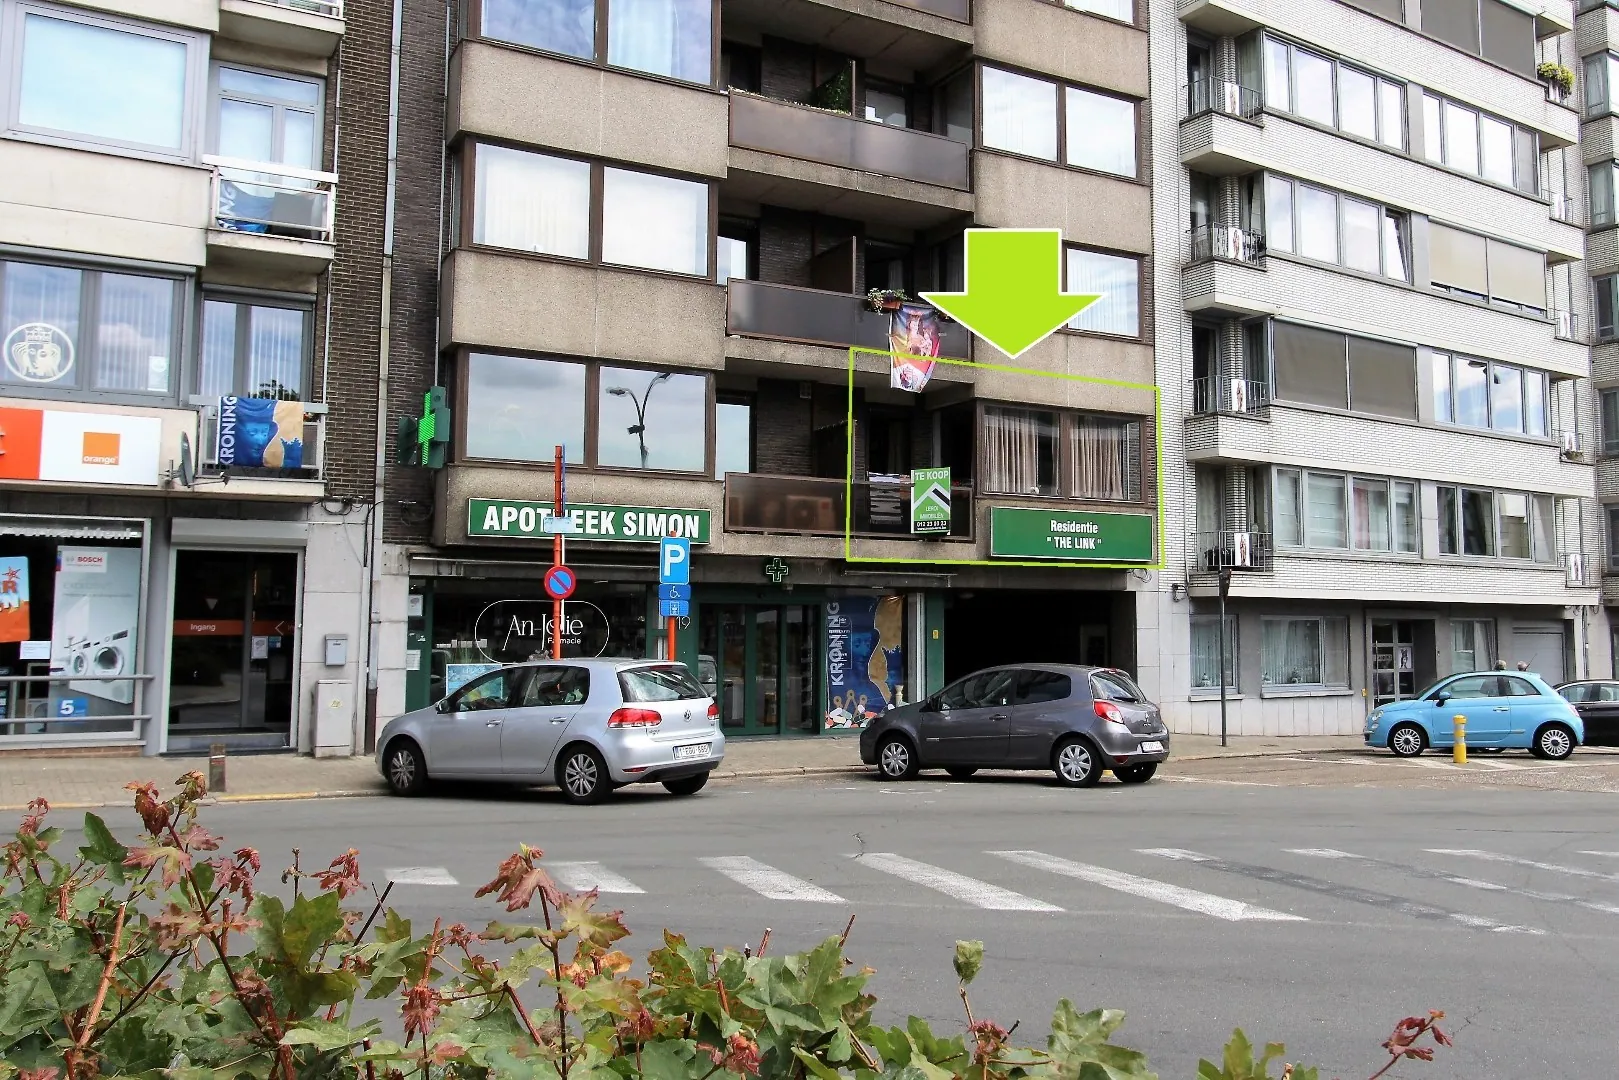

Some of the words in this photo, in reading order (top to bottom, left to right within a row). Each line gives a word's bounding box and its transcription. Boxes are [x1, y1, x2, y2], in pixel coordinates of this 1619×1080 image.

[83, 455, 117, 465] orange
[914, 472, 925, 481] TE
[926, 470, 949, 480] KOOP
[482, 505, 616, 536] APOTEEK
[622, 511, 700, 539] SIMON
[1050, 519, 1099, 534] Residentie
[1074, 537, 1096, 550] LINK
[663, 543, 686, 577] P
[190, 623, 217, 632] Ingang
[675, 615, 691, 630] 19
[547, 636, 582, 645] Famacie
[826, 602, 844, 686] KRONING
[60, 699, 75, 715] 5
